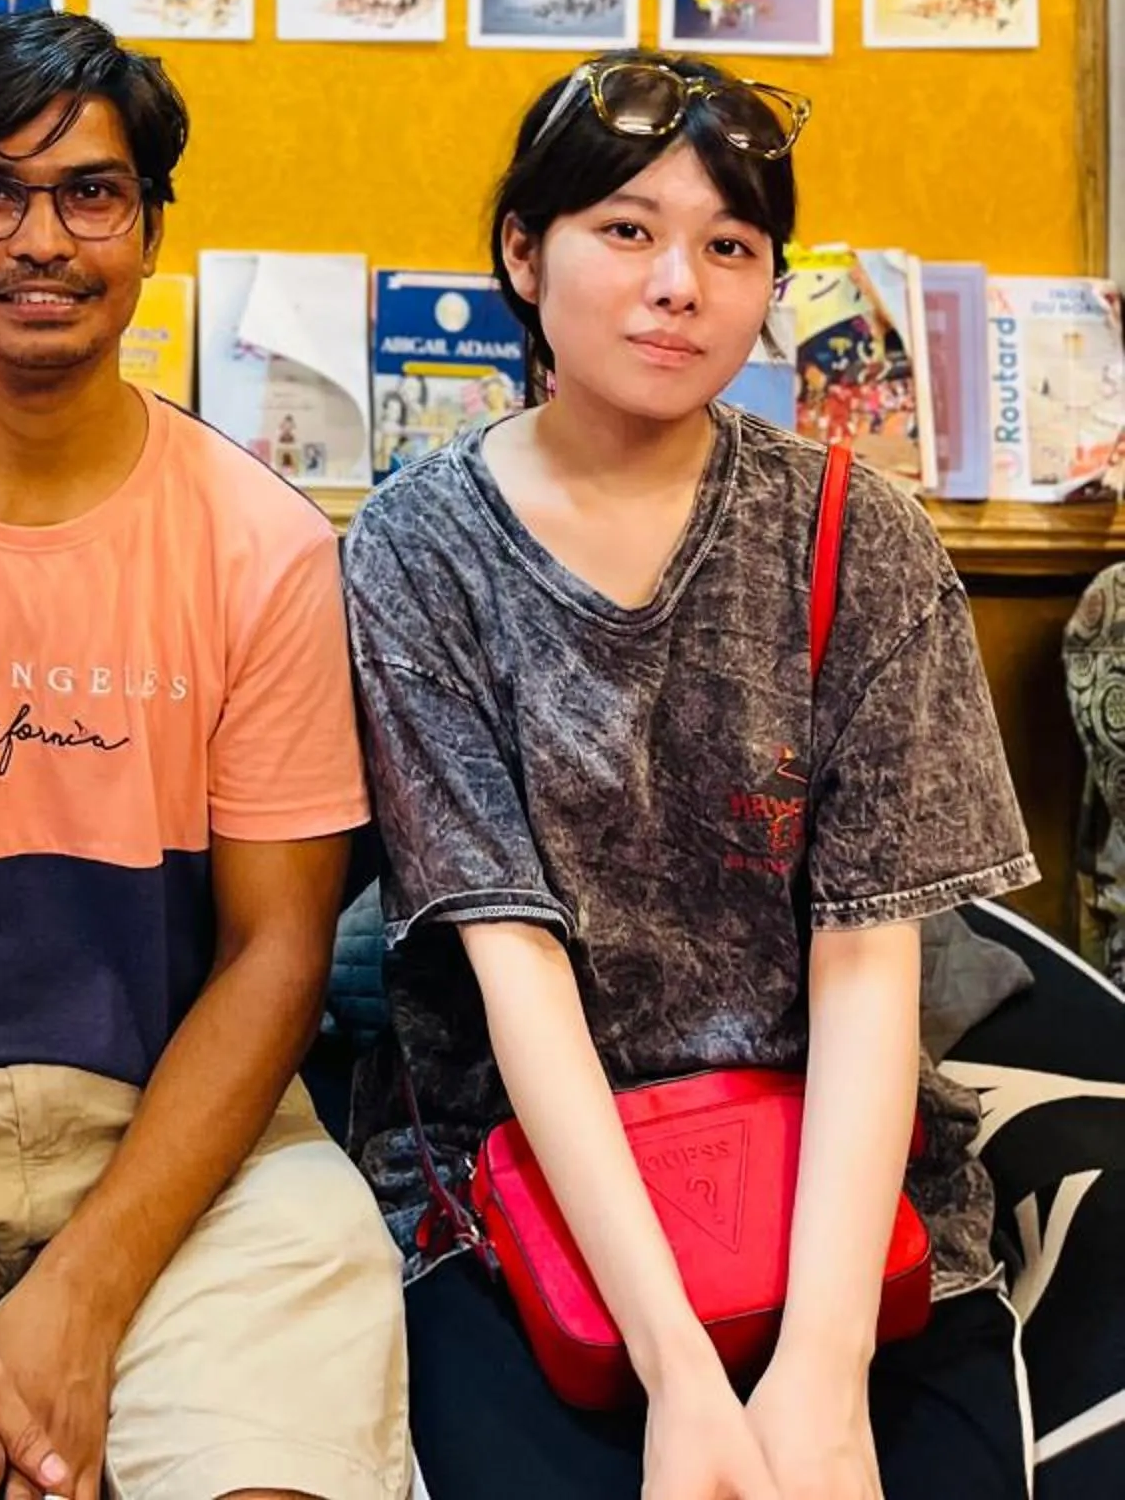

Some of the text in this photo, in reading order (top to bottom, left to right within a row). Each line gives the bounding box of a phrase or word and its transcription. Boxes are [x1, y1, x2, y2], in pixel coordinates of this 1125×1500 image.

[380, 336, 522, 360] ABIGAIL ADAMS
[988, 316, 1021, 444] Routard
